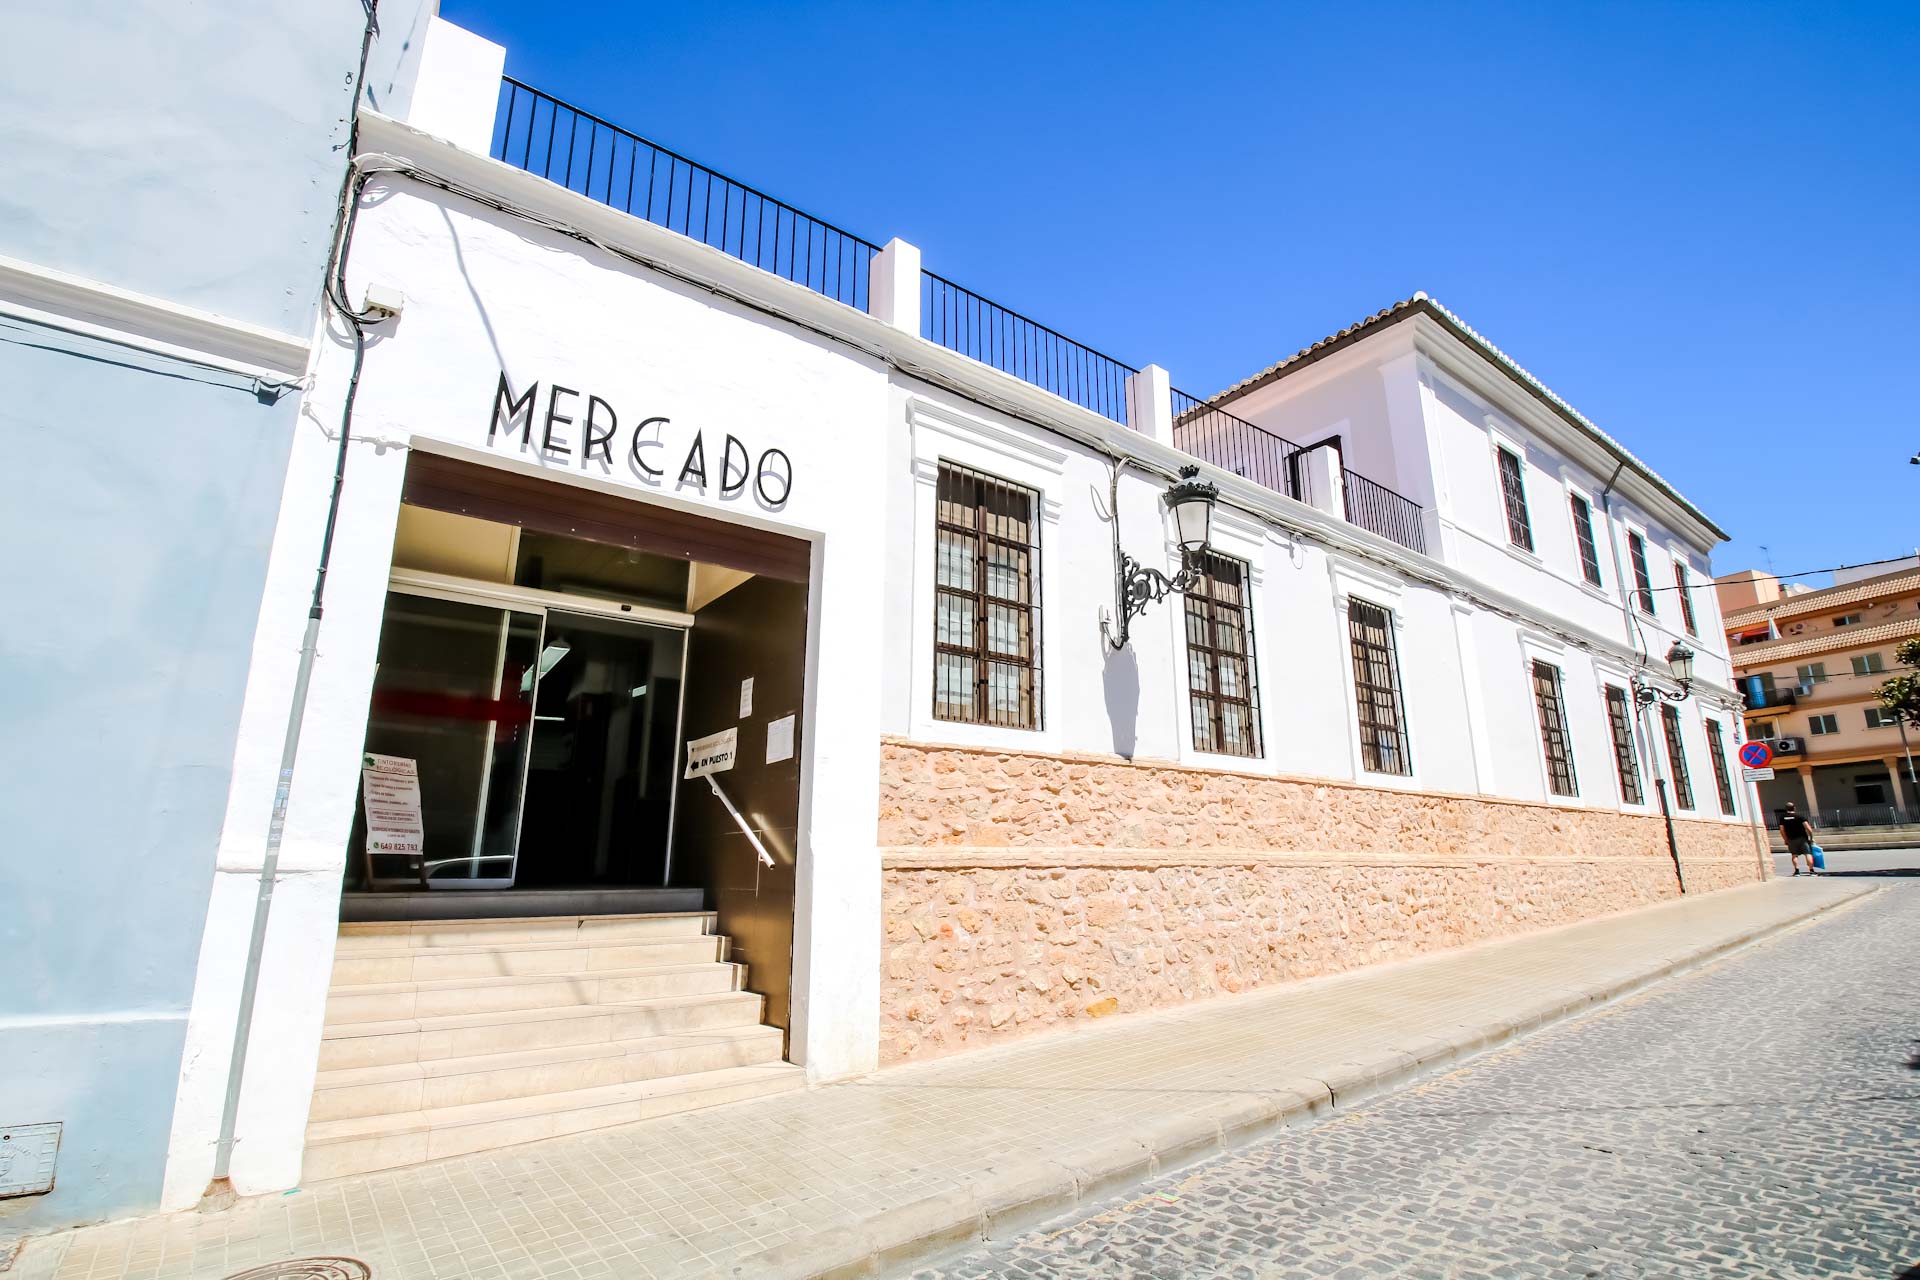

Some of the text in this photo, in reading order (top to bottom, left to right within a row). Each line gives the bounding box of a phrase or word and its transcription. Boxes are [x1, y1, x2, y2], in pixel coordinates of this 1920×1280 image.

[489, 369, 792, 505] MERCADO
[701, 758, 708, 767] EN
[709, 752, 729, 766] PUESTO
